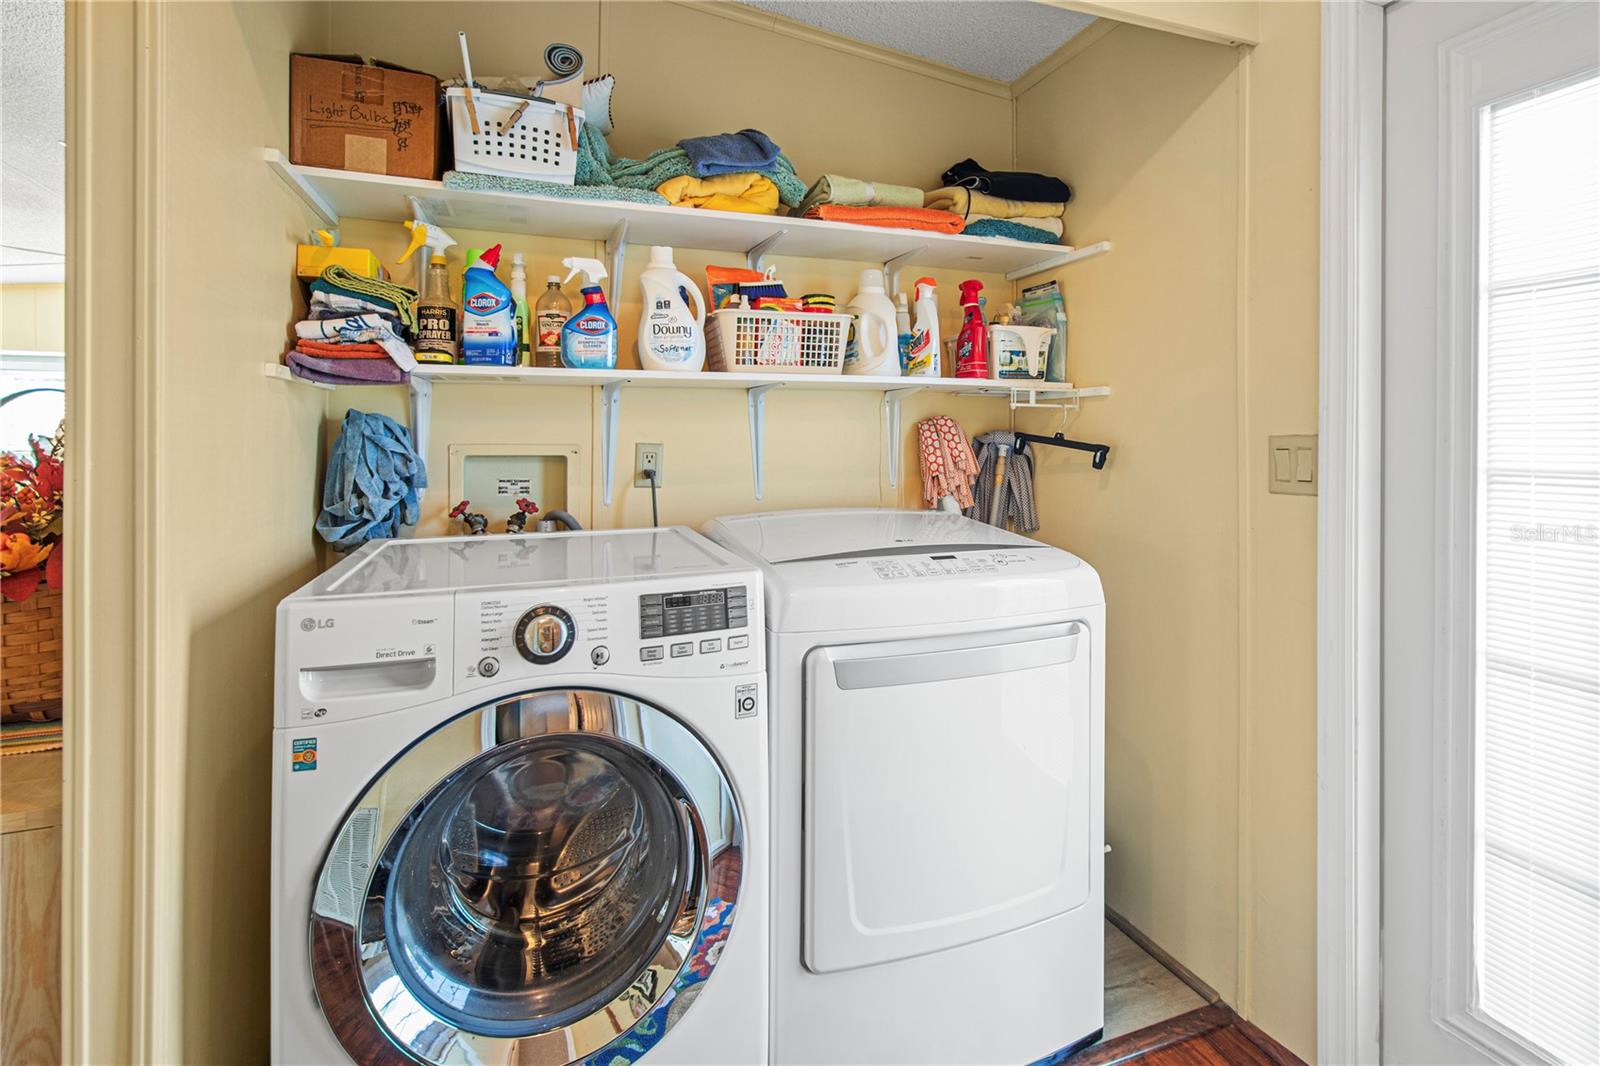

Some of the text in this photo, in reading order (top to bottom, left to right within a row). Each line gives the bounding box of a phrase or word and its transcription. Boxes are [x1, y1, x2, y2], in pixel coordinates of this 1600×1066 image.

[308, 95, 391, 124] Light Bulbs
[470, 298, 497, 307] CLOROX
[421, 309, 447, 317] HARRIS
[419, 318, 450, 330] PRO
[580, 320, 606, 330] CLOROX
[419, 330, 452, 340] SPRAYER
[652, 323, 692, 338] Downy
[318, 618, 335, 629] LG
[375, 649, 416, 659] Direct Drive
[738, 696, 755, 713] 10
